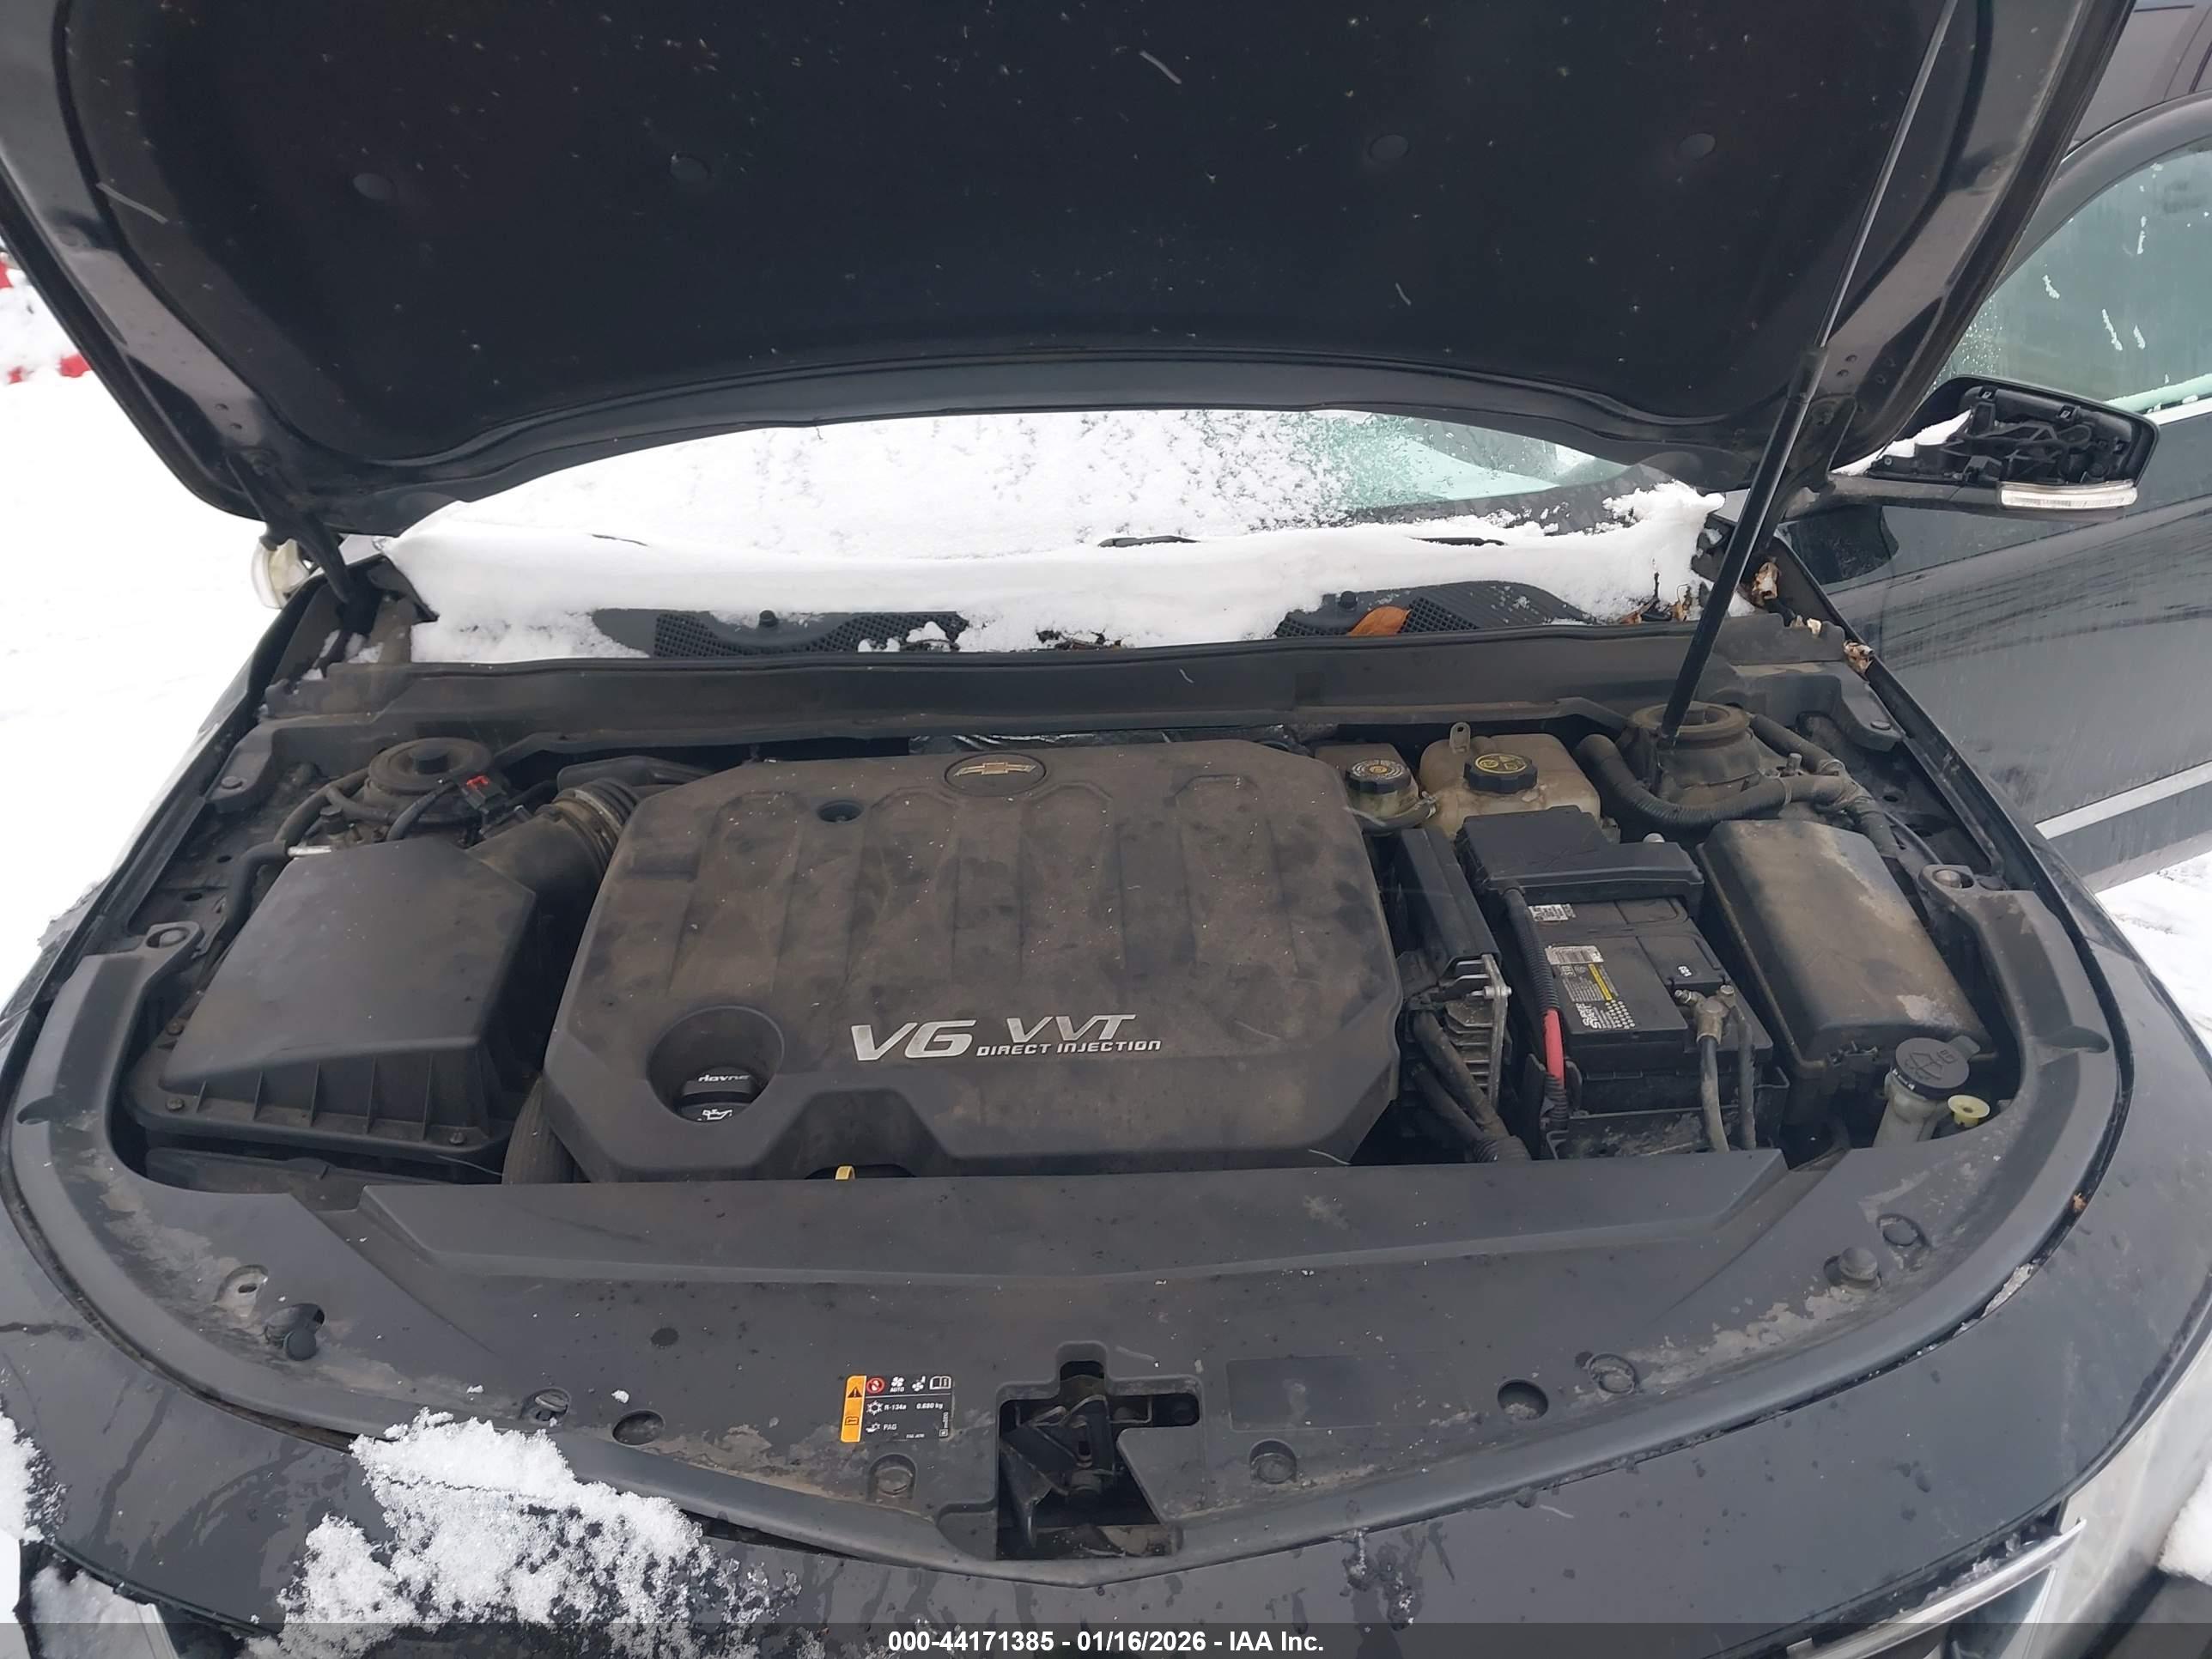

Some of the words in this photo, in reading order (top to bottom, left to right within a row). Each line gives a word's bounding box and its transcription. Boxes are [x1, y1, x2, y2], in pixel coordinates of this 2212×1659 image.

[851, 1019, 977, 1061] V6
[1006, 1014, 1137, 1043] VVT
[975, 1043, 1052, 1057] DIRECT
[1056, 1040, 1162, 1054] INJECTION
